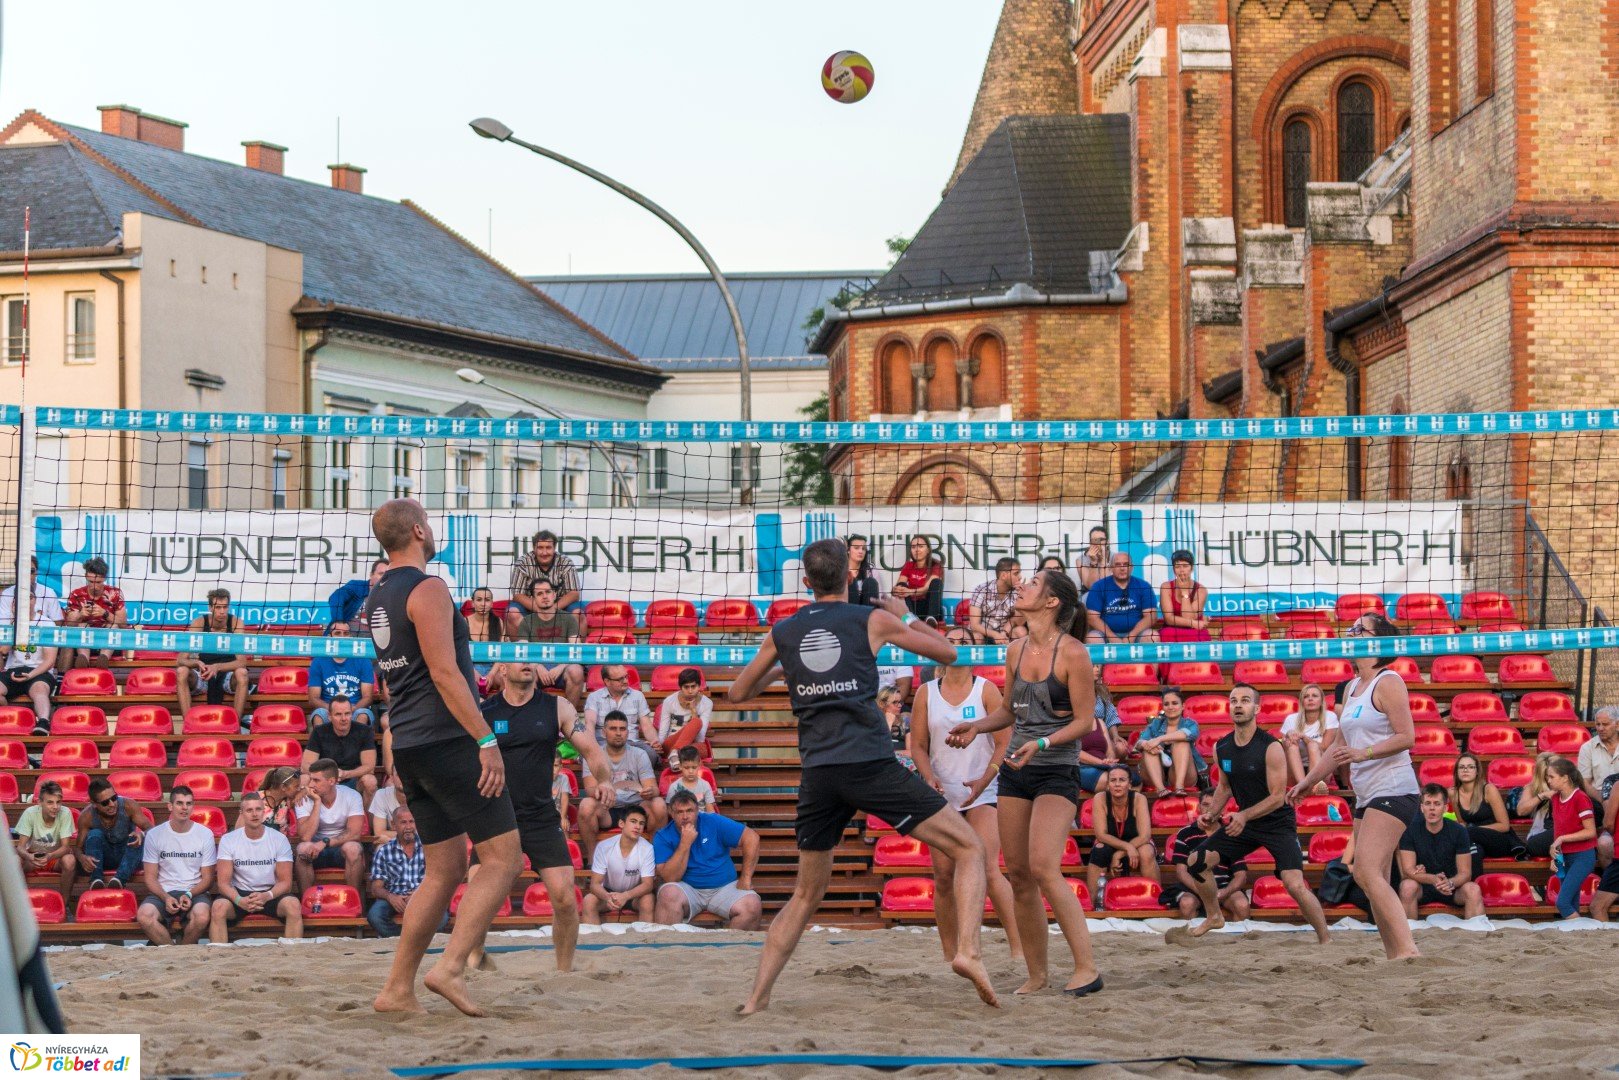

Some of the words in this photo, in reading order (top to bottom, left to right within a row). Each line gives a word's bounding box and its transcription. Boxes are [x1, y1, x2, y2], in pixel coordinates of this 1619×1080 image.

[124, 536, 385, 574] HÜBNER-H
[486, 535, 745, 573] HBNER-H
[1203, 529, 1455, 567] HÜBNER-H
[796, 678, 858, 696] Coloplast
[160, 850, 197, 860] Continental
[234, 859, 272, 867] Continental
